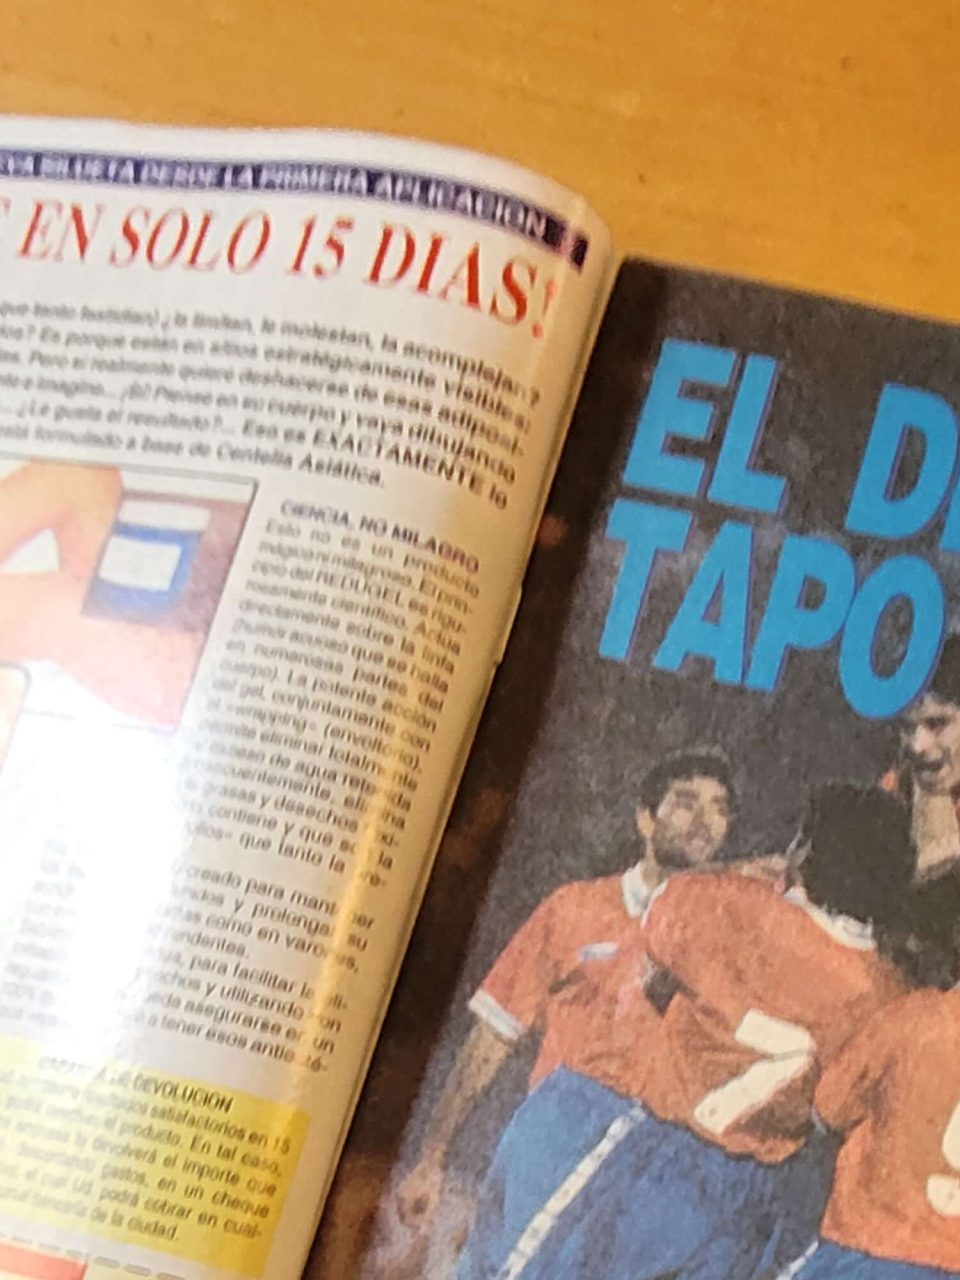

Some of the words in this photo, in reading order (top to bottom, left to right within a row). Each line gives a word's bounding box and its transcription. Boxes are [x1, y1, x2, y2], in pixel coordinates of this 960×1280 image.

[373, 170, 548, 240] APLICACION
[17, 198, 106, 263] EN
[109, 203, 271, 275] SOLO
[286, 213, 355, 278] 15
[364, 220, 558, 340] DIAS!
[621, 338, 789, 514] EL
[313, 427, 483, 497] EXACTAMENTE
[280, 500, 354, 528] CIENCIA,
[360, 515, 388, 536] NO
[392, 527, 480, 575] MILAGRO
[311, 529, 331, 543] no
[342, 536, 360, 550] es
[372, 544, 393, 559] un
[403, 554, 479, 598] producto
[408, 599, 428, 615] es
[598, 496, 947, 719] TAPO
[346, 623, 394, 646] sobre
[401, 637, 416, 655] la
[421, 645, 455, 675] linfa
[351, 647, 384, 665] que
[387, 652, 407, 673] se
[410, 660, 449, 693] halla
[312, 678, 377, 707] potente
[382, 696, 437, 733] acción
[353, 667, 407, 695] partes
[418, 691, 445, 713] del
[272, 692, 395, 734] conjuntamente
[400, 731, 430, 752] con
[270, 753, 290, 768] de
[295, 760, 337, 783] agua
[274, 796, 358, 832] desechos
[240, 832, 271, 849] que
[278, 836, 322, 866] tanto
[329, 854, 345, 873] la
[245, 877, 284, 900] para
[206, 913, 252, 935] como
[257, 928, 279, 943] en
[190, 954, 228, 975] para
[233, 959, 295, 993] facilitar
[185, 997, 281, 1035] asegurarse
[220, 983, 304, 1022] utilizando
[134, 1073, 234, 1114] DEVOLUCION
[694, 1007, 817, 1134] 7
[119, 1120, 184, 1148] producto.
[189, 1136, 211, 1154] En
[216, 1143, 236, 1161] tal
[241, 1153, 282, 1177] caso,
[150, 1103, 246, 1141] satisfactorios
[249, 1131, 268, 1145] en
[272, 1136, 291, 1155] 15
[157, 1176, 177, 1191] en
[184, 1183, 205, 1199] un
[211, 1187, 270, 1218] cheque
[163, 1155, 177, 1168] el
[182, 1159, 240, 1185] importe
[247, 1177, 277, 1197] que
[99, 1187, 139, 1207] podrá
[143, 1195, 193, 1220] cobrar
[197, 1211, 218, 1226] en
[223, 1217, 263, 1239] cual-
[128, 1214, 179, 1241] ciudad.
